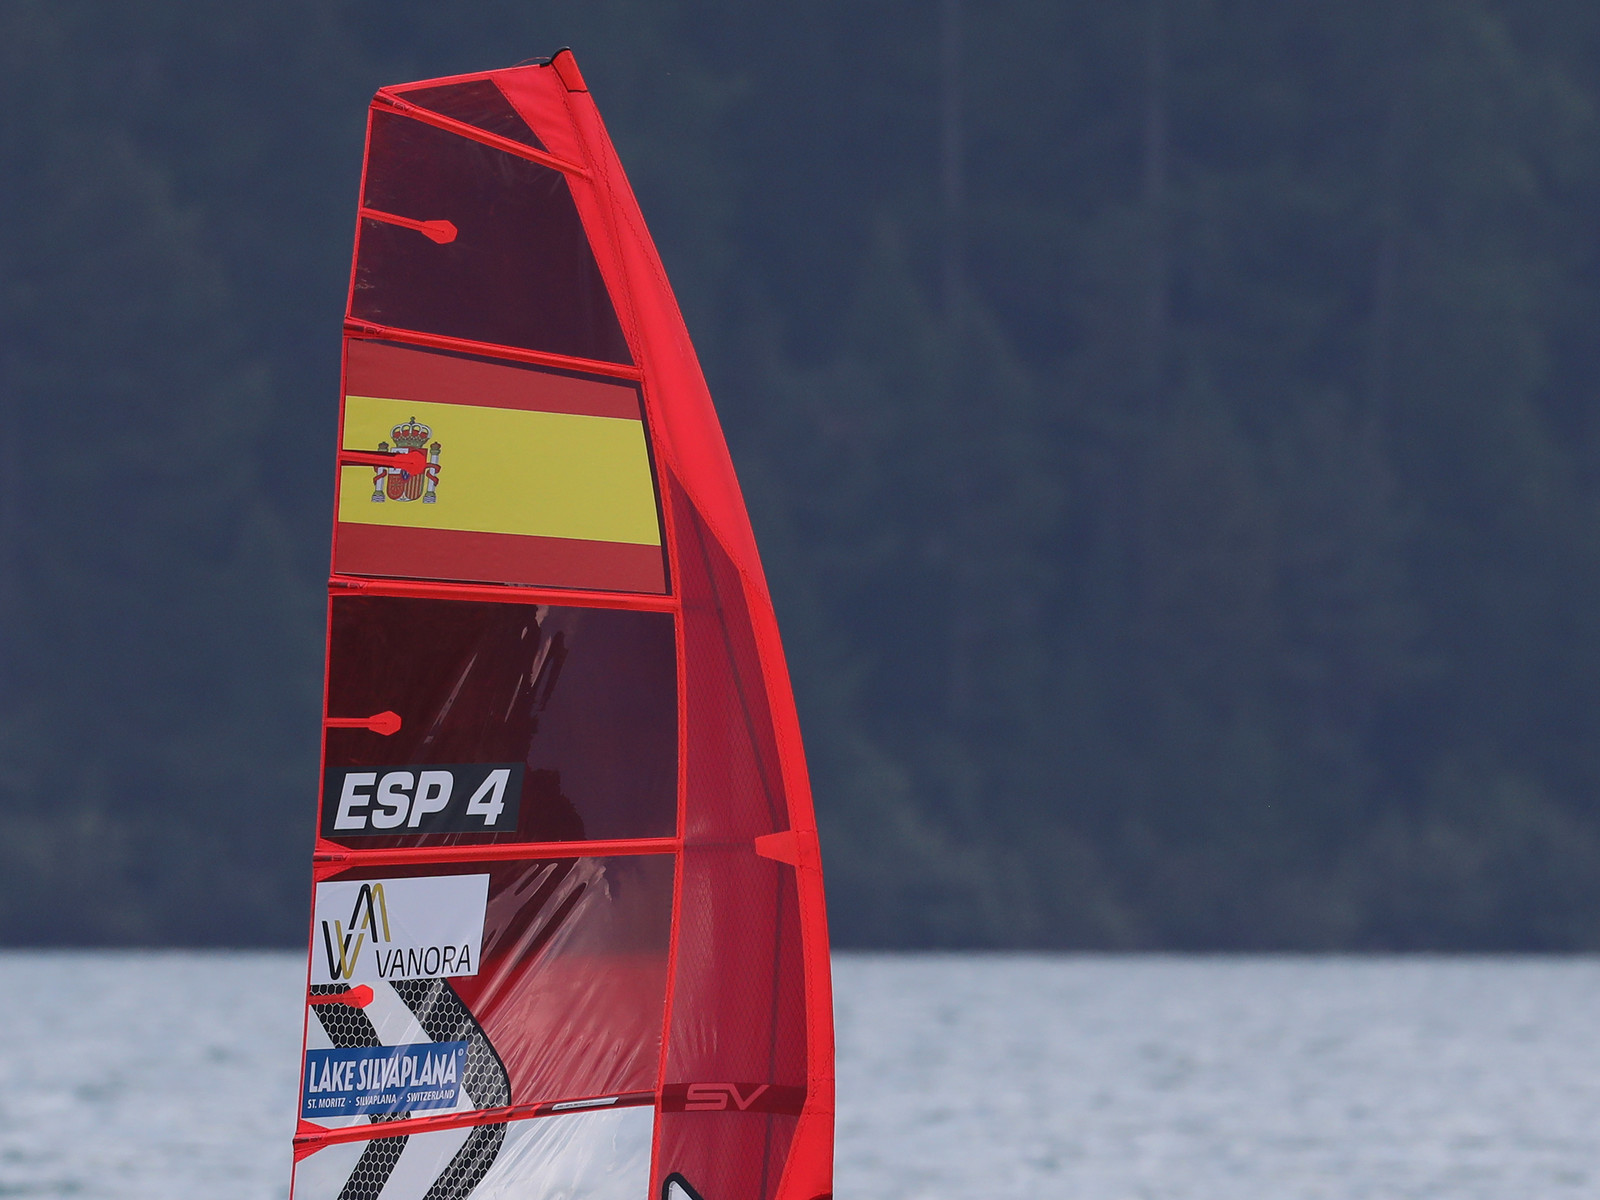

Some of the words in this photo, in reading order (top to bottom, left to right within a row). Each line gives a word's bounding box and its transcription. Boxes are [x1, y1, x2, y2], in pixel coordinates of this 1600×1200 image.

[333, 770, 454, 830] ESP
[465, 769, 511, 826] 4
[375, 944, 471, 978] VANORA
[308, 1056, 356, 1093] LAKE
[356, 1049, 457, 1093] SILVAPLANA
[307, 1099, 318, 1109] ST.
[318, 1097, 346, 1108] MORITZ
[355, 1094, 397, 1106] SILVAPLANA
[406, 1088, 455, 1103] SWITZERLAND
[685, 1083, 770, 1111] SV
